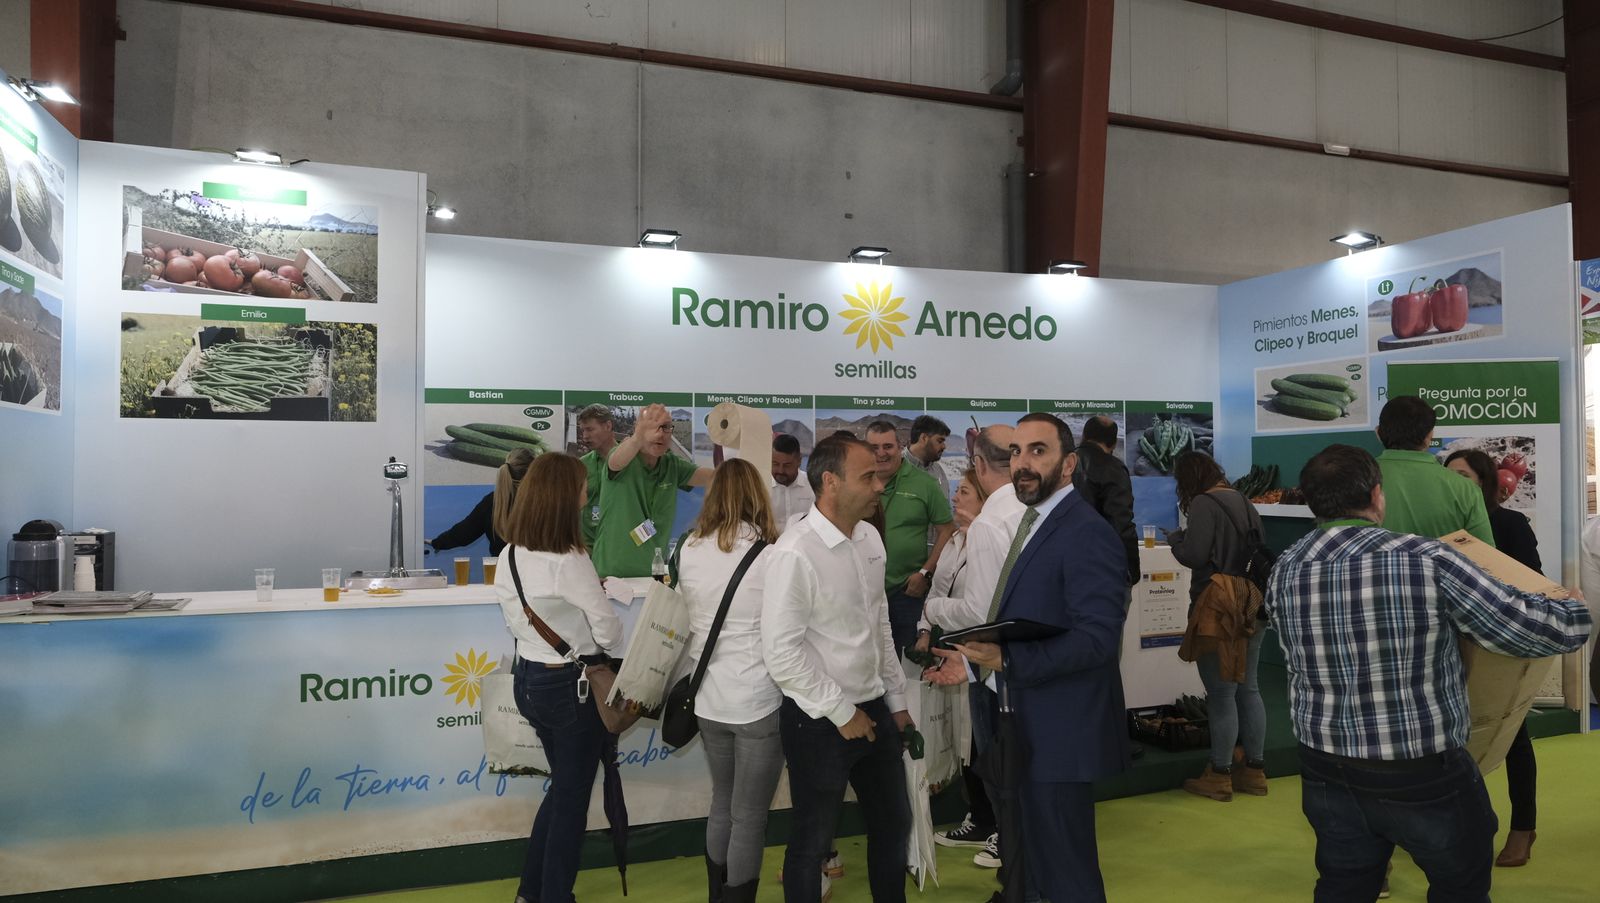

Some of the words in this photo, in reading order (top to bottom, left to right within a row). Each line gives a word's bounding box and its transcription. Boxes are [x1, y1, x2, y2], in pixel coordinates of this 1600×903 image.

[241, 309, 268, 319] Emilia
[672, 287, 829, 332] Ramiro
[915, 301, 1058, 341] Arnedo
[1253, 314, 1308, 334] Pimientos
[1311, 305, 1359, 324] Menes,
[1254, 336, 1294, 354] Clipeo
[1296, 335, 1304, 350] y
[1307, 323, 1358, 345] Broquel
[834, 360, 917, 380] semillas
[469, 390, 504, 399] Bastian
[608, 393, 644, 401] Trabuco
[1418, 387, 1481, 402] Pregunta
[1486, 387, 1510, 400] por
[1514, 386, 1527, 397] la
[707, 395, 736, 404] Menes,
[737, 395, 764, 404] Clipeo
[765, 397, 771, 405] y
[772, 396, 802, 405] Broquel
[852, 397, 868, 405] Tina
[876, 398, 895, 406] Sade
[970, 399, 997, 408] Quijano
[1086, 401, 1116, 409] Mirambel
[1166, 402, 1194, 410] Salvatore
[525, 408, 551, 416] CGMMV
[300, 668, 433, 703] Ramiro
[240, 771, 284, 825] de
[290, 766, 323, 809] la
[456, 753, 488, 792] al
